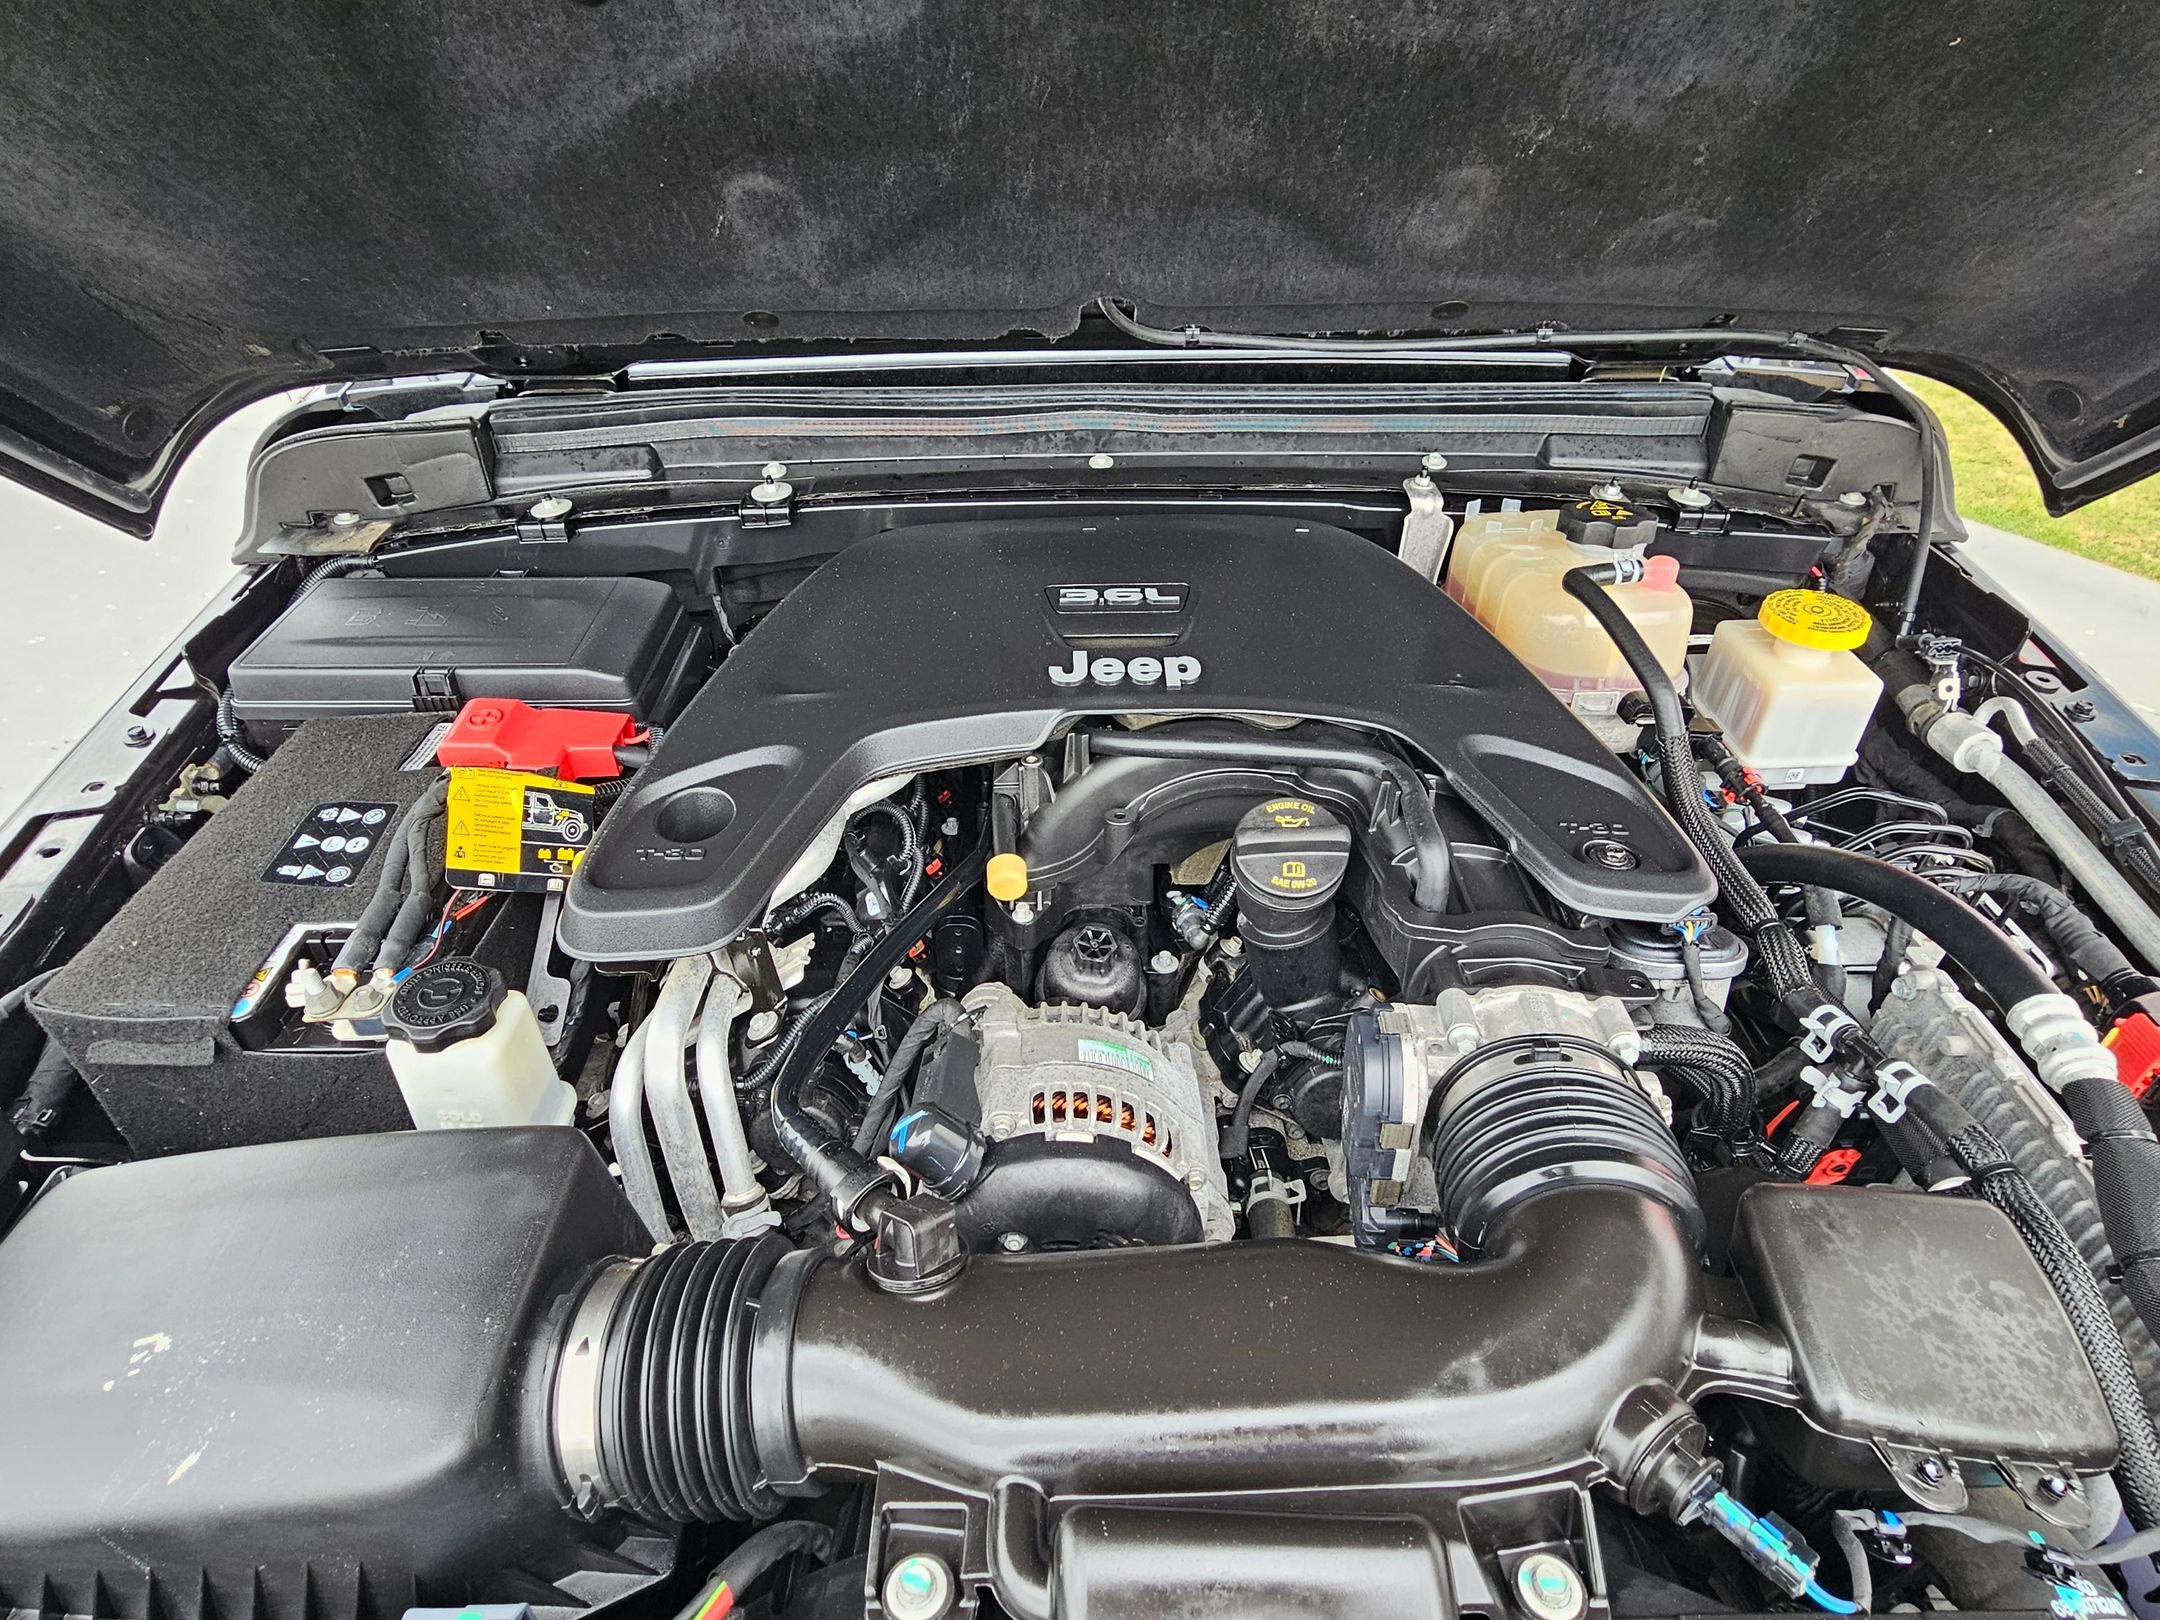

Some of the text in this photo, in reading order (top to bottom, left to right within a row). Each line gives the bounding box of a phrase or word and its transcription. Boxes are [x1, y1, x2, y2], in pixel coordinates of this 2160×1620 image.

[1058, 587, 1180, 606] 3.6L
[1048, 650, 1202, 690] Jeep
[1265, 801, 1316, 815] ENGINE OIL
[1271, 876, 1318, 889] SAE 0W-20
[400, 974, 422, 995] FLUID
[397, 1006, 446, 1026] APPROVED
[436, 1108, 483, 1123] COLD
